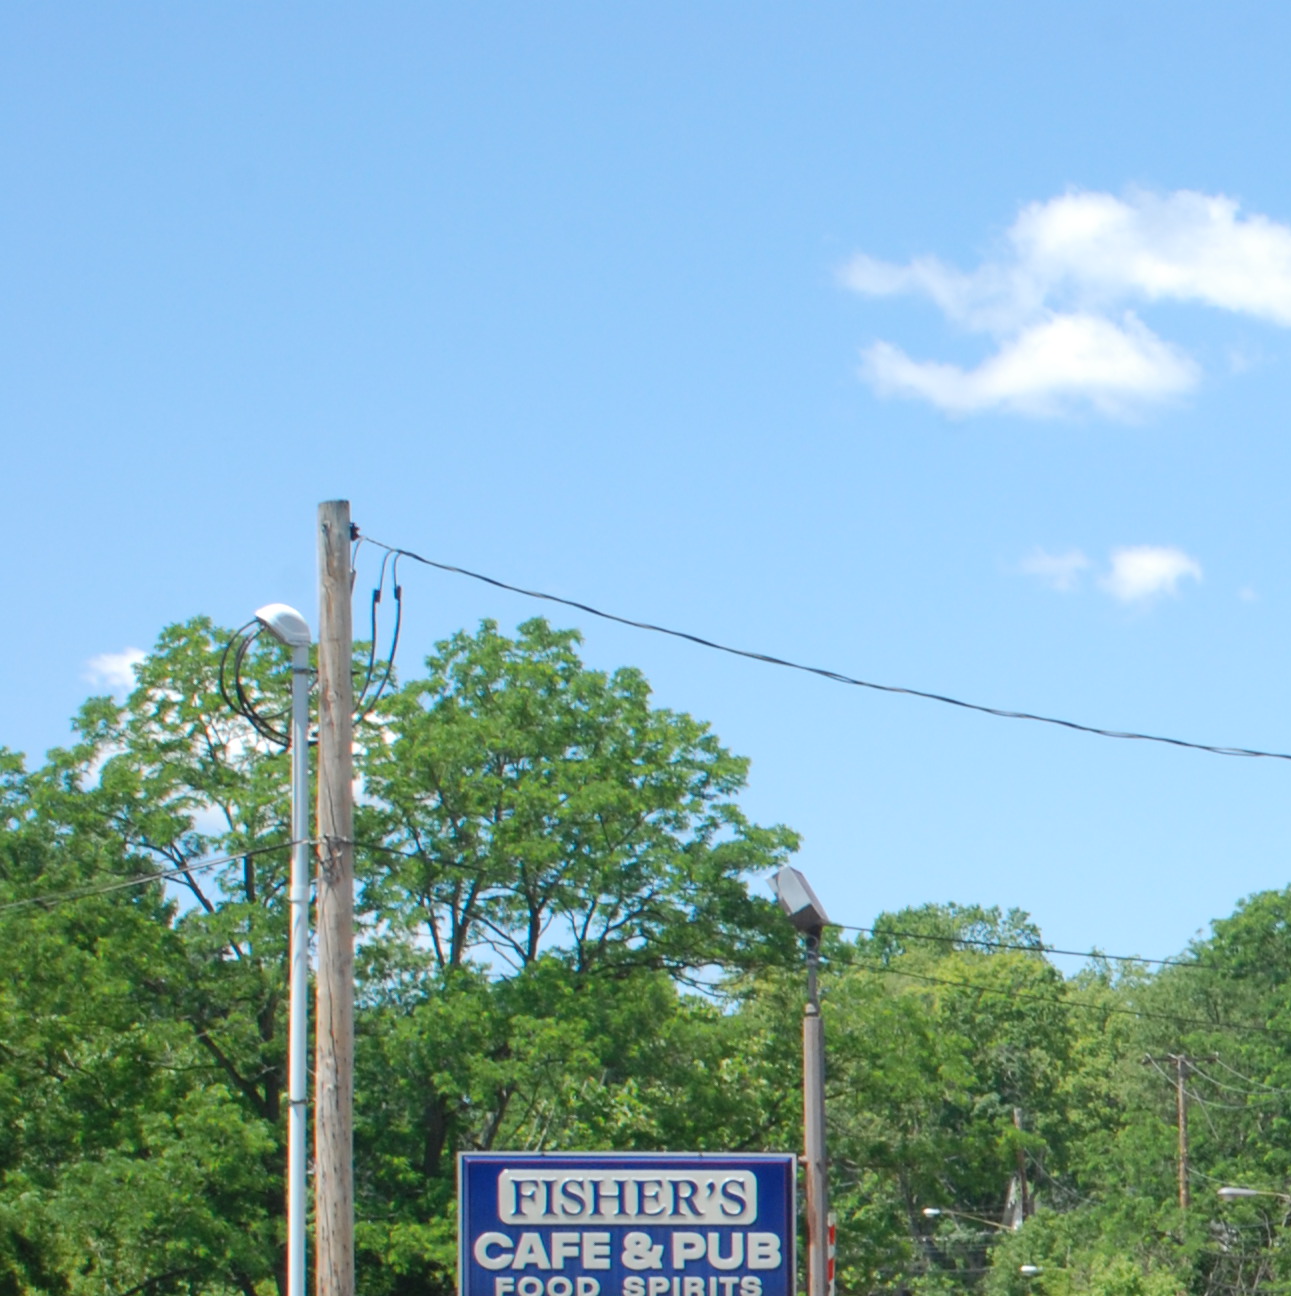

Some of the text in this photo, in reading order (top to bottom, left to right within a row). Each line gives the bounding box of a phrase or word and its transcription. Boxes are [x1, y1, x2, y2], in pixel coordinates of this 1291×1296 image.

[509, 1178, 748, 1217] FISHER'S
[474, 1232, 782, 1270] CAFE & PUB
